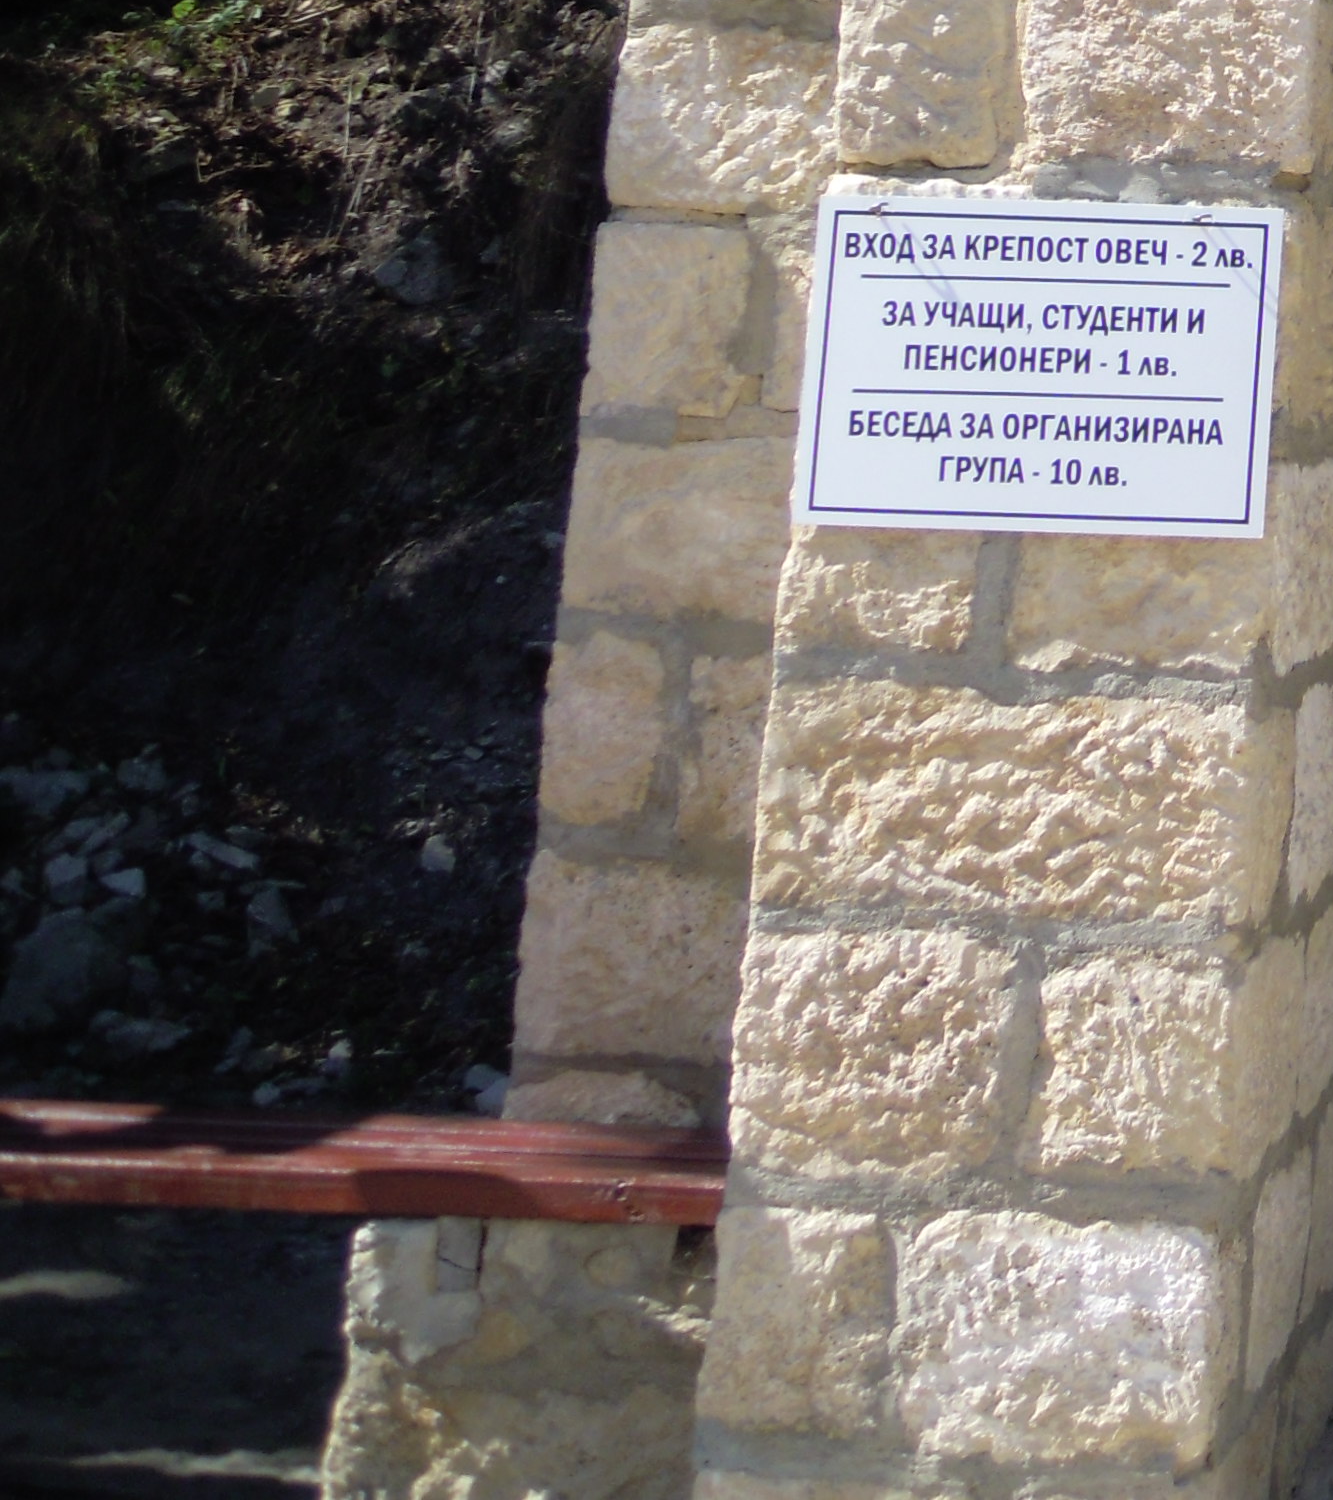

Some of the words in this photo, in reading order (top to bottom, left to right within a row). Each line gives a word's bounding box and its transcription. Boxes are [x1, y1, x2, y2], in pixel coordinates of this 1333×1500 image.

[844, 232, 916, 264] ВХОД
[922, 233, 956, 260] ЗА
[964, 234, 1090, 263] КРЕПОСТ
[1095, 238, 1168, 266] ОВЕЧ
[1191, 241, 1208, 267] 2
[1214, 248, 1253, 269] лв.
[882, 300, 916, 327] ЗА
[924, 301, 1032, 334] УЧАЩИ,
[1042, 304, 1178, 336] СТУДЕНТИ
[1187, 308, 1205, 335] И
[904, 344, 1091, 374] ПЕНСИОНЕРИ
[1117, 349, 1131, 375] 1
[1138, 356, 1177, 377] лв.
[848, 410, 952, 443] БЕСЕДА
[959, 412, 994, 439] ЗА
[1002, 413, 1223, 446] ОРГАНИЗИРАНА
[939, 455, 1025, 484] ГРУПА
[1050, 458, 1082, 485] 10
[1088, 466, 1127, 487] лв.
